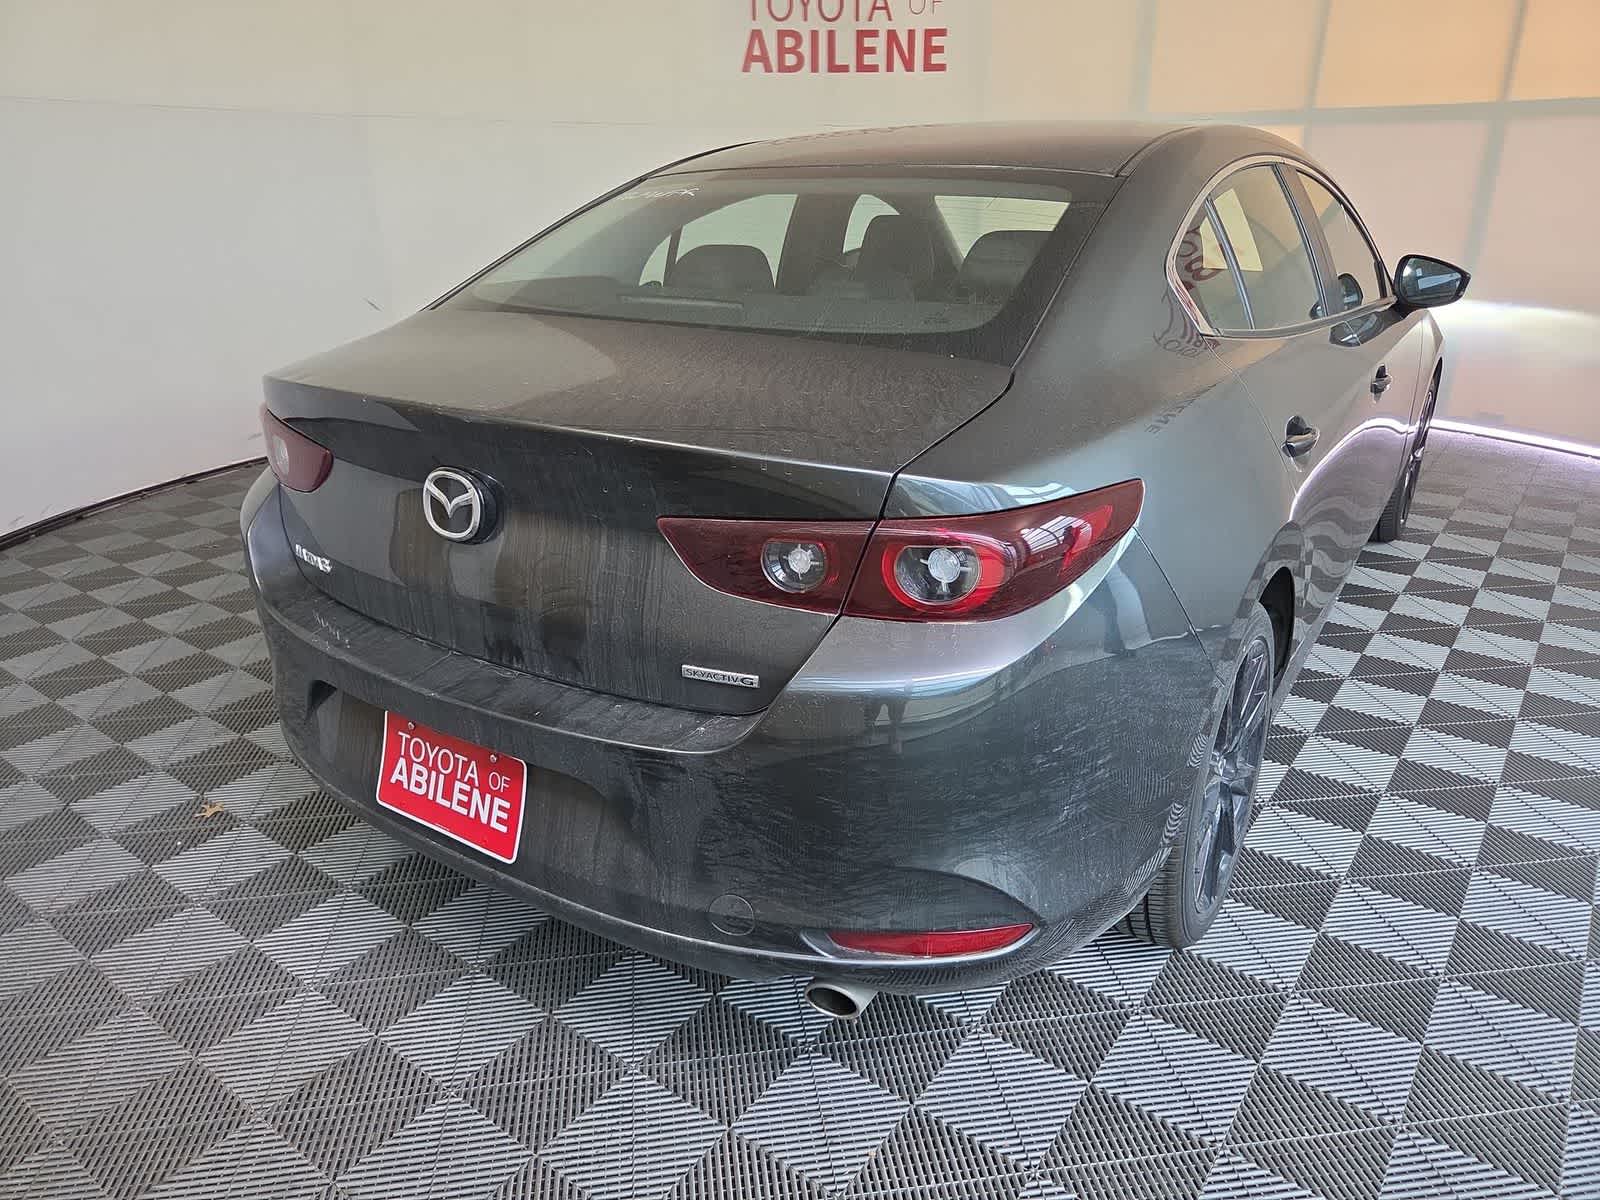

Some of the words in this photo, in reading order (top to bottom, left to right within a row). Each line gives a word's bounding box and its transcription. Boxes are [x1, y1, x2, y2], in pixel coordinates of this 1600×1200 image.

[742, 28, 948, 73] ABILENE
[398, 732, 479, 787] TOYOTA
[488, 772, 511, 792] OF
[390, 757, 511, 833] ABILENE
